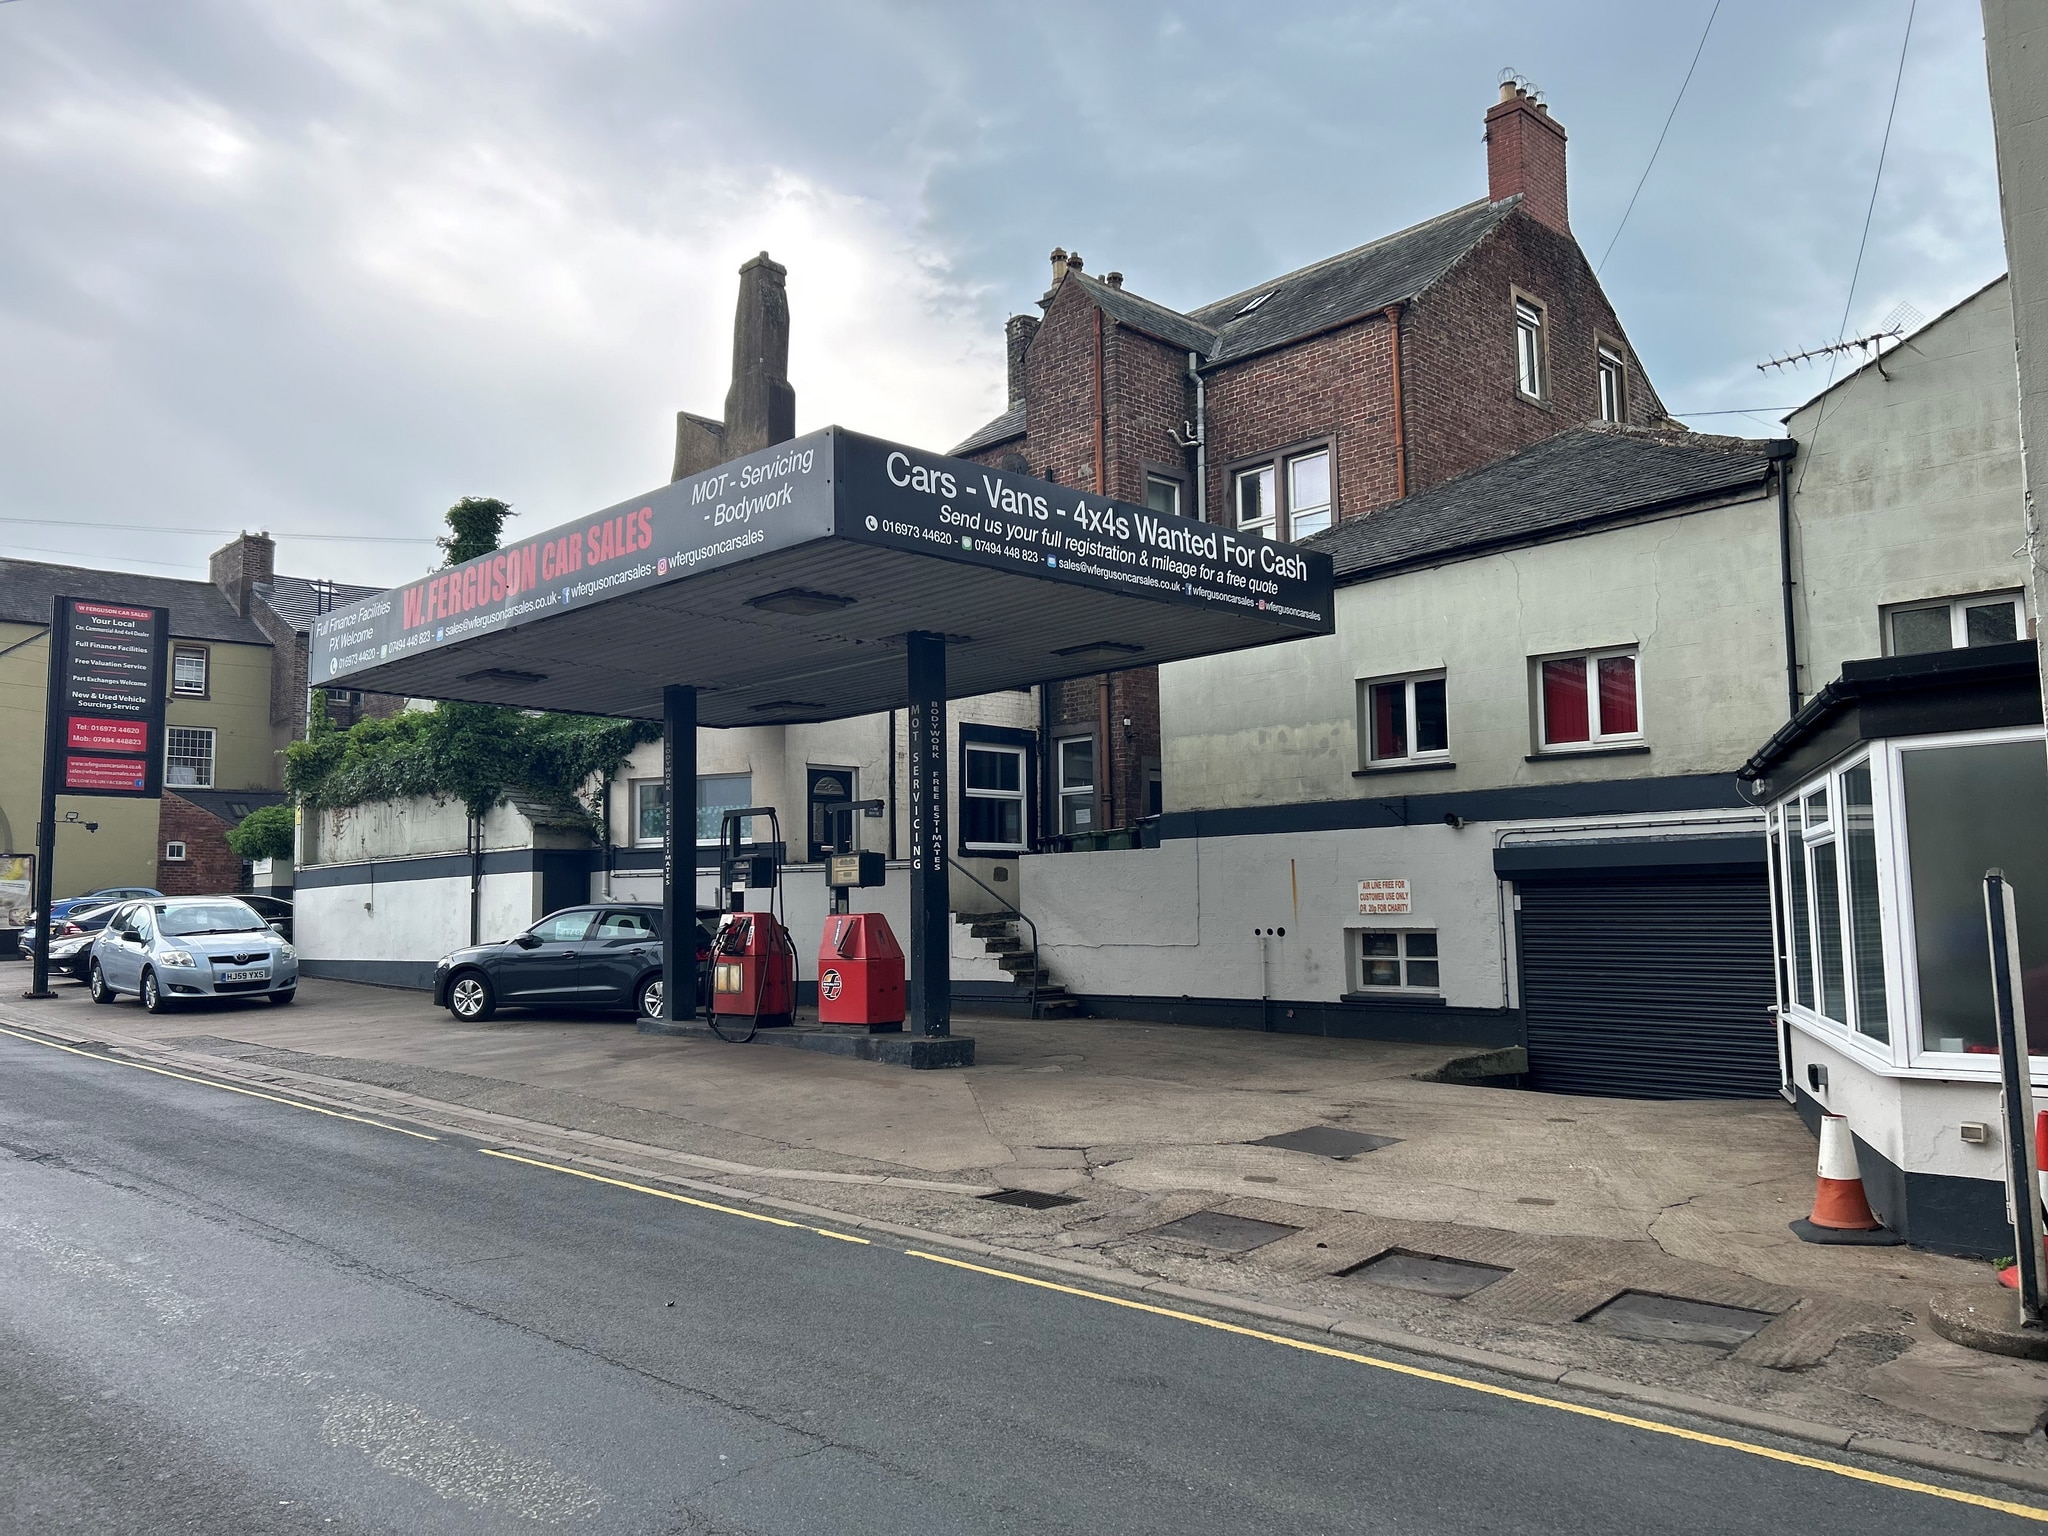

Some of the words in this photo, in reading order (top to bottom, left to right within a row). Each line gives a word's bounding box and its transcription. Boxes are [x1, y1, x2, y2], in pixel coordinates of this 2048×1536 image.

[691, 474, 728, 505] MOT
[740, 449, 814, 488] Servicing
[714, 483, 793, 526] Bodywork
[887, 452, 957, 499] Cars
[983, 475, 1048, 520] Vans
[1073, 500, 1129, 540] 4x4s
[1134, 513, 1216, 560] Wanted
[1223, 536, 1255, 568] For
[1260, 545, 1307, 581] Cash
[542, 533, 582, 581] CAR
[587, 506, 653, 566] SALES
[939, 505, 980, 529] Send
[985, 519, 1002, 535] us
[1006, 523, 1038, 541] your
[1041, 528, 1061, 547] full
[1065, 537, 1136, 564] registration
[1139, 551, 1149, 566] &
[1152, 555, 1197, 579] mileage
[1199, 564, 1215, 581] for
[1217, 570, 1224, 583] a
[1226, 571, 1246, 588] free
[1248, 577, 1278, 595] quote
[882, 520, 920, 538] 016973
[922, 528, 952, 544] 44620
[974, 539, 1001, 555] 07494
[1004, 545, 1020, 558] 448
[1022, 550, 1038, 563] 823
[1058, 557, 1180, 592] sales@wfergusoncarsales.co.uk
[1193, 587, 1254, 607] wfergusoncarsales
[1265, 603, 1320, 621] wfergusoncarsales
[339, 654, 358, 669] 016973
[359, 648, 375, 661] 44620
[389, 639, 405, 653] 07494
[406, 634, 418, 647] 448
[419, 630, 431, 644] 823
[445, 593, 557, 637] sales@wfergusoncarsales.co.uk
[571, 563, 651, 598] wfergusoncarsales
[668, 530, 764, 569] wfergusoncarsales
[92, 617, 111, 625] Your
[113, 619, 135, 627] Local
[316, 620, 329, 638] Full
[329, 613, 356, 633] Finance
[358, 600, 391, 623] Facilities
[90, 642, 117, 650] Finance
[118, 645, 147, 653] Facilities
[329, 636, 341, 652] PX
[340, 627, 373, 648] Welcome
[90, 660, 122, 668] Valuation
[78, 700, 111, 710] Sourcing
[119, 695, 146, 703] Vehicle
[911, 705, 920, 741] MOT
[930, 701, 940, 759] BODYWORK
[913, 752, 921, 870] SERVICING
[933, 805, 941, 870] ESTIMATES
[1360, 893, 1385, 901] CUSTOMER
[1386, 892, 1395, 900] USE
[1396, 892, 1408, 900] ONLY
[1371, 881, 1381, 889] LINE
[1383, 881, 1394, 889] FREE
[1377, 904, 1387, 912] FOR
[1388, 904, 1408, 912] CHARITY
